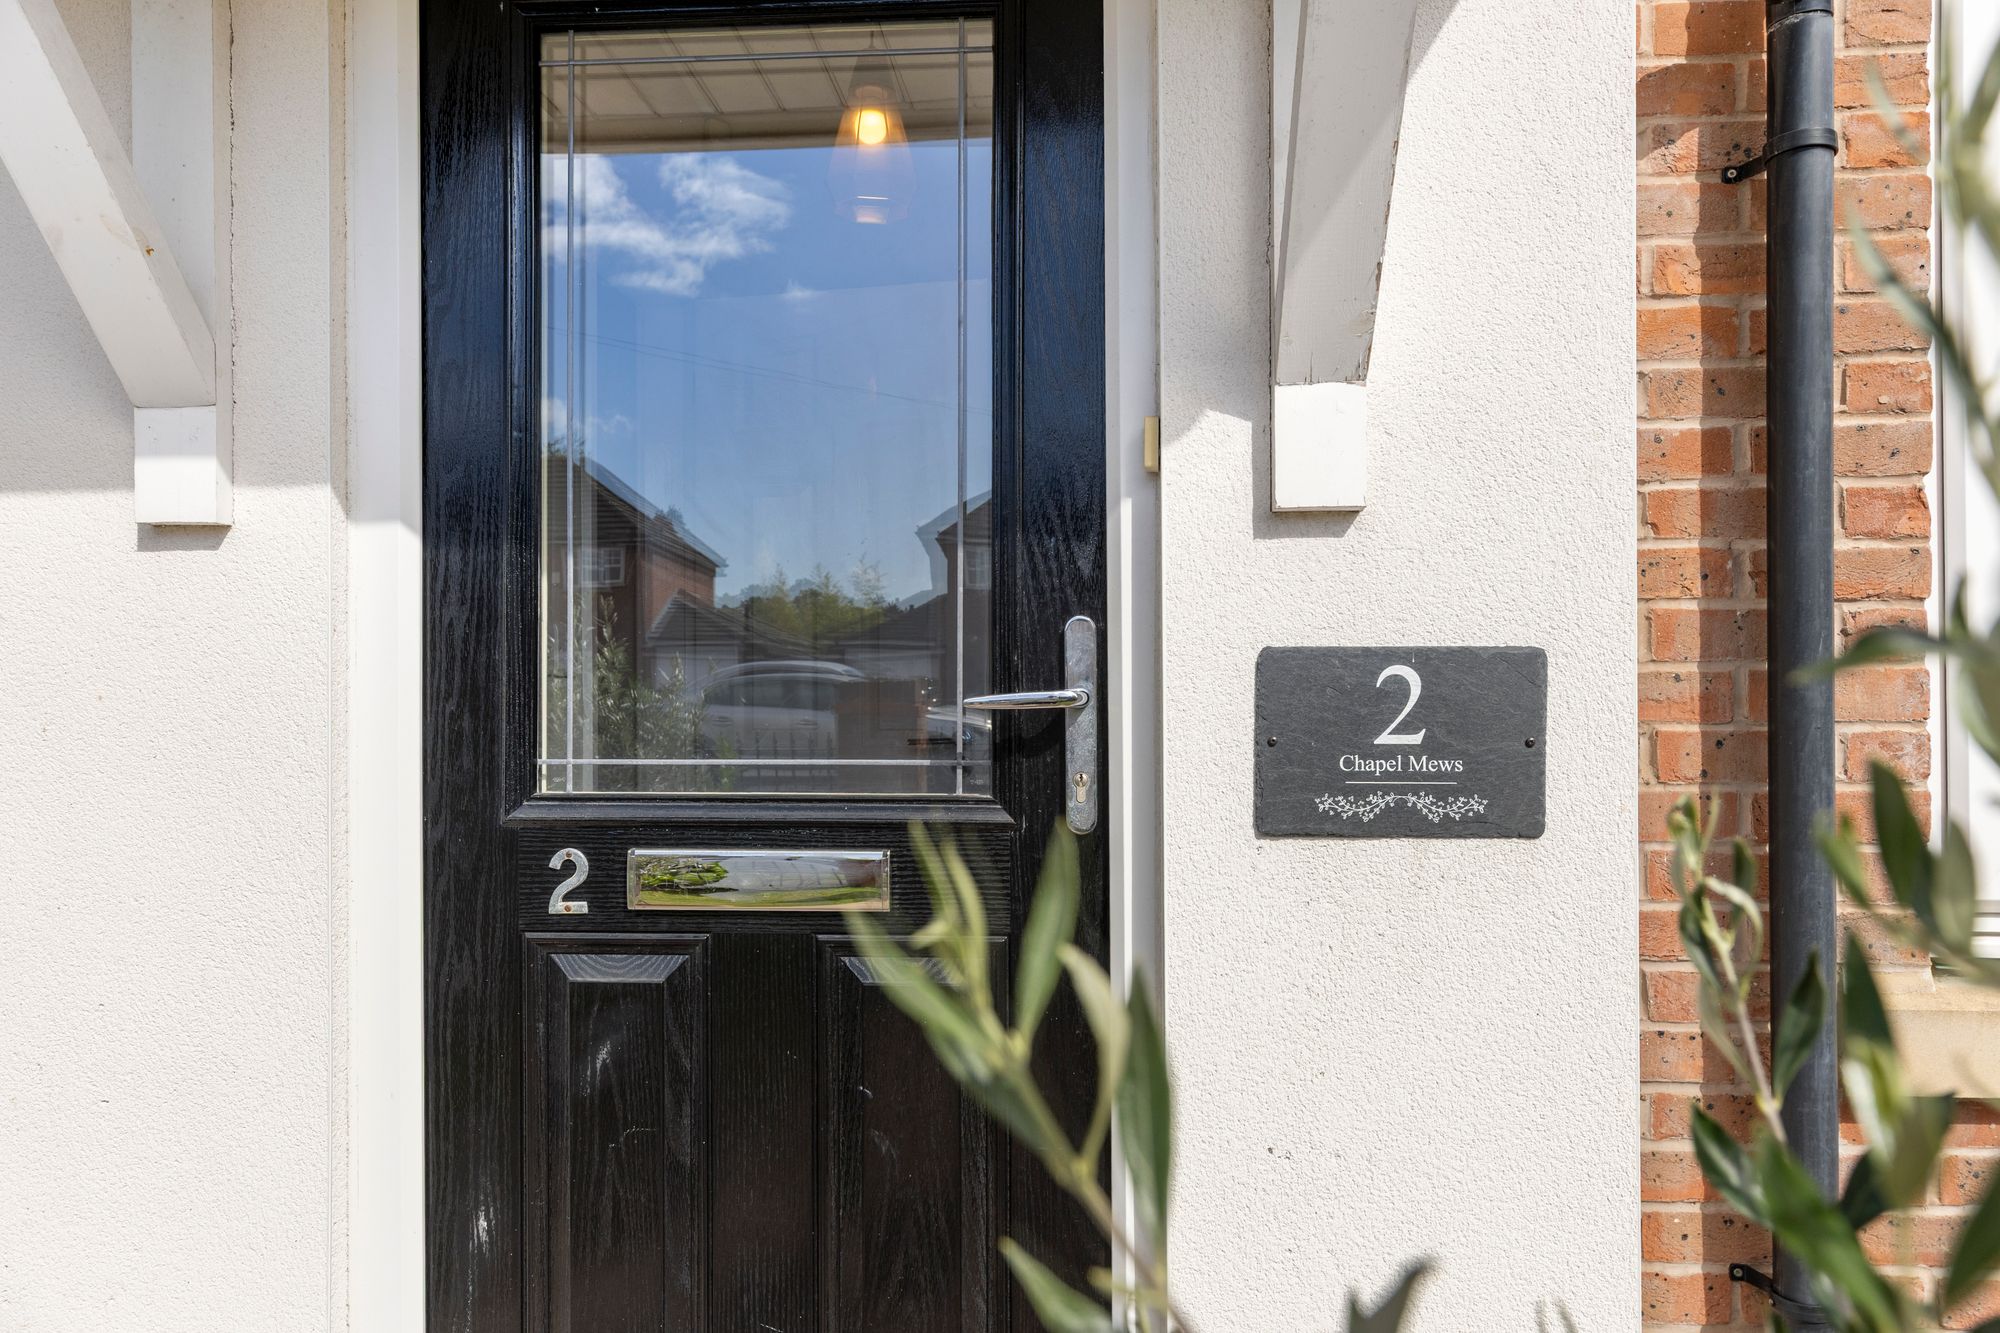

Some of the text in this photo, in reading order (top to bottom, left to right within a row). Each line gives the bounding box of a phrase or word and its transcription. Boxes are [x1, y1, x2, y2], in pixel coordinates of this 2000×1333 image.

[1373, 664, 1427, 745] 2
[1339, 755, 1463, 776] Chapel Mews
[548, 847, 589, 914] 2
